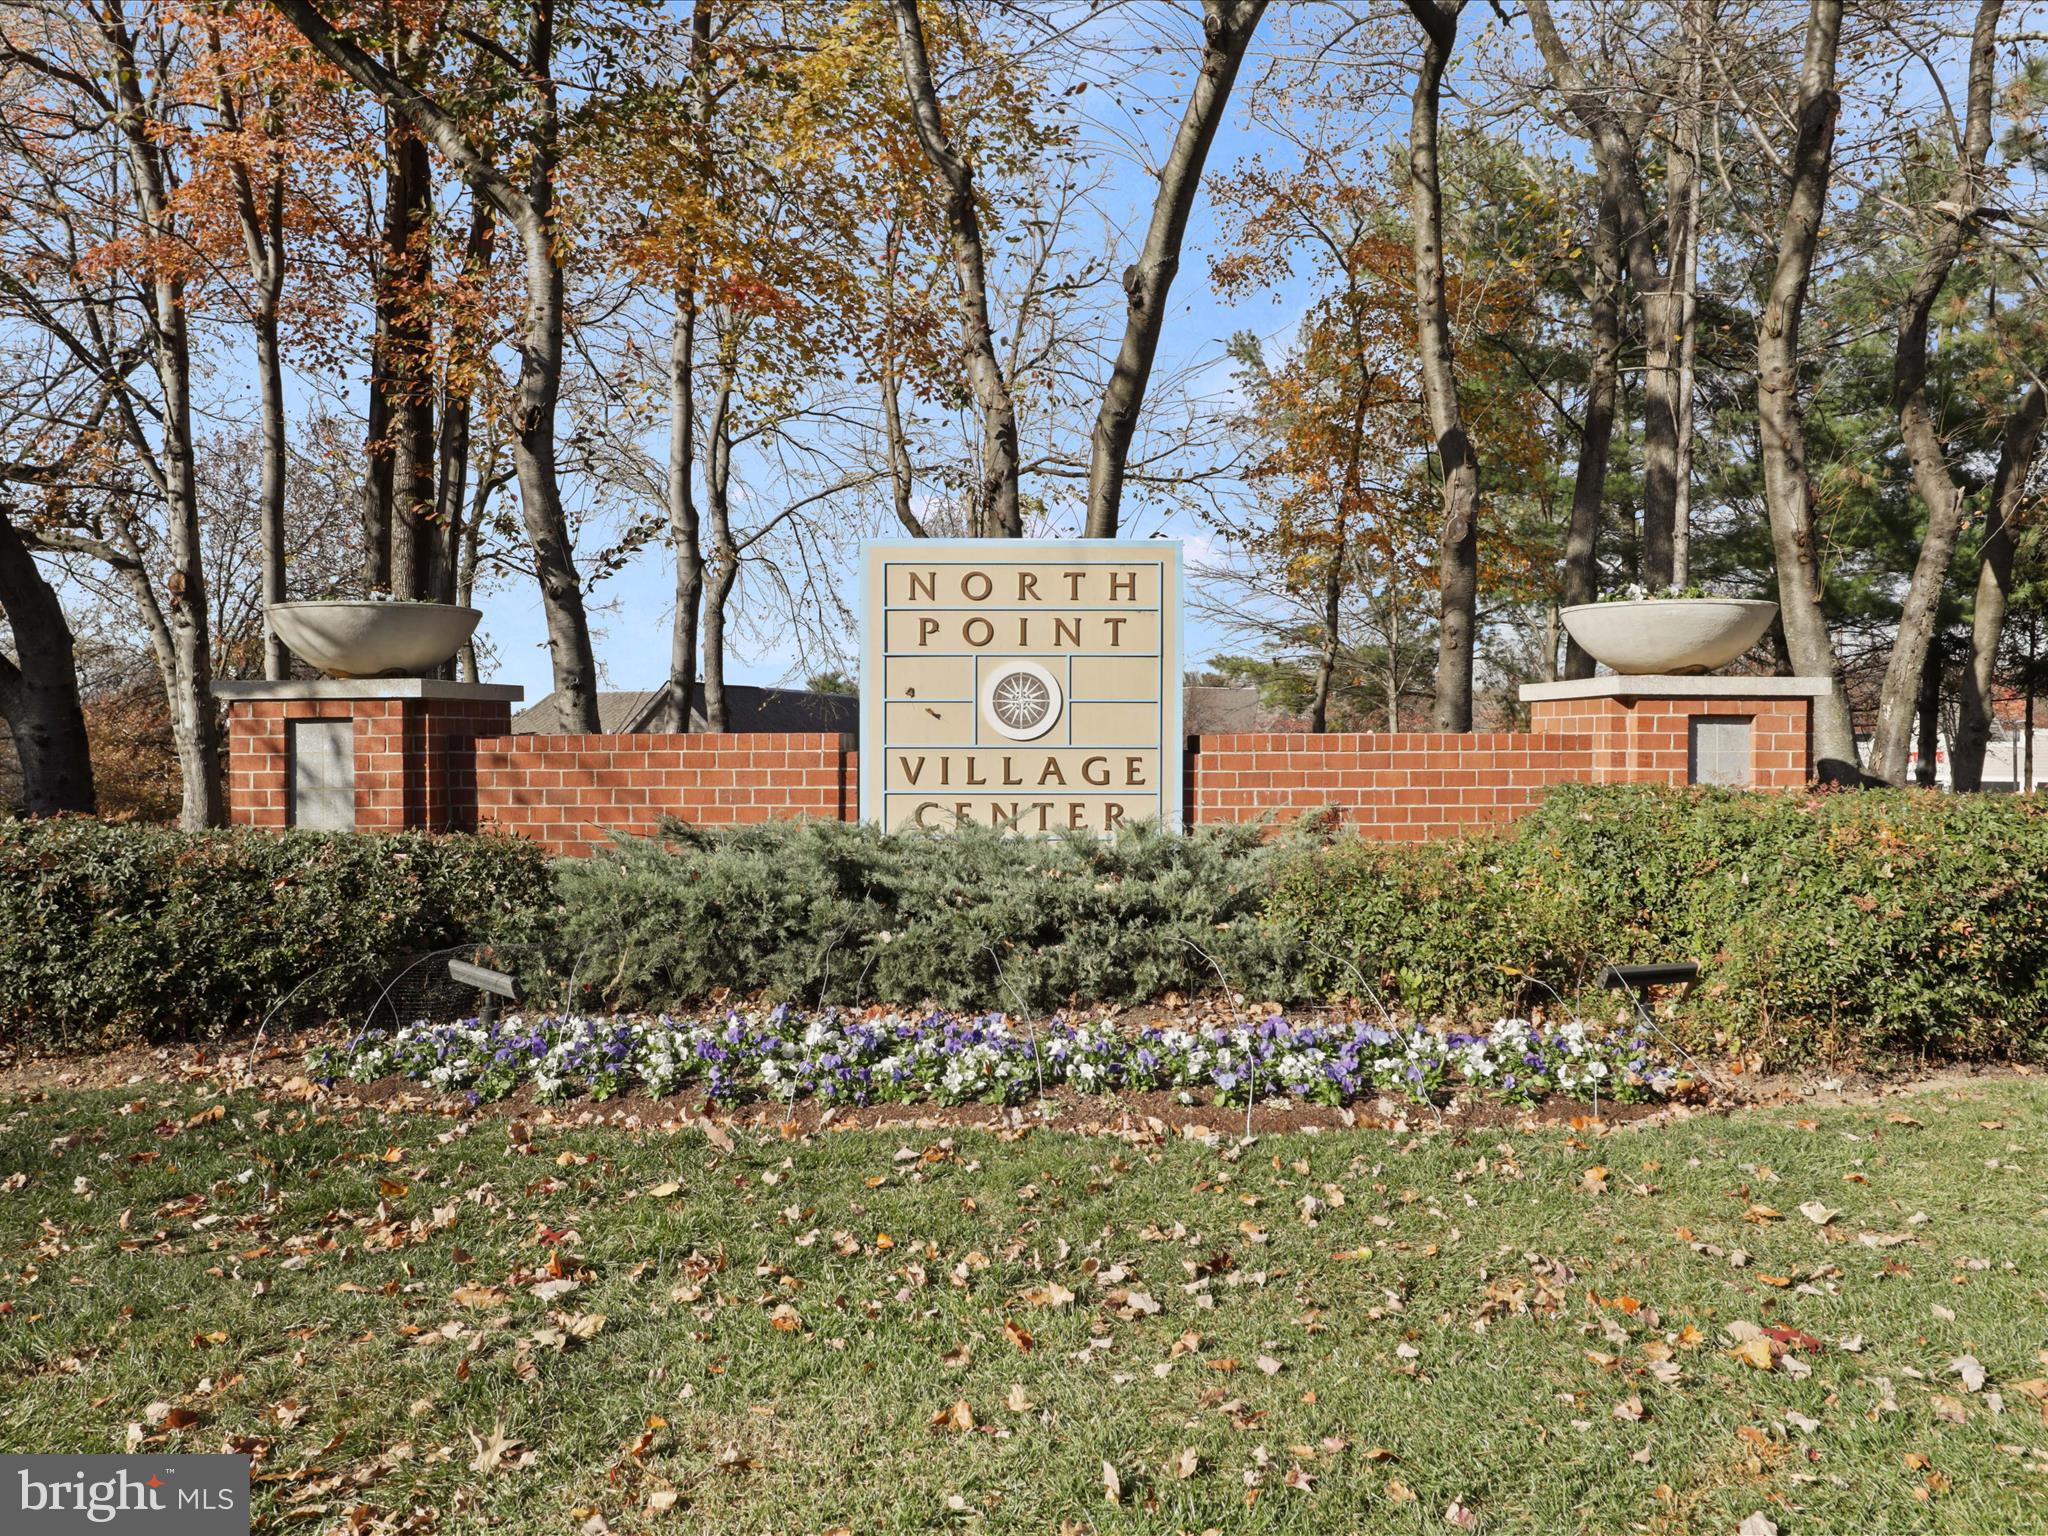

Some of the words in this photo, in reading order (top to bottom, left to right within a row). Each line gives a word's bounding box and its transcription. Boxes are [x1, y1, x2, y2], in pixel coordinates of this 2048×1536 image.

[908, 571, 1137, 601] NORTH
[918, 617, 1127, 647] POINT
[899, 756, 1146, 786] VILLAGE
[914, 802, 1126, 832] CENTER
